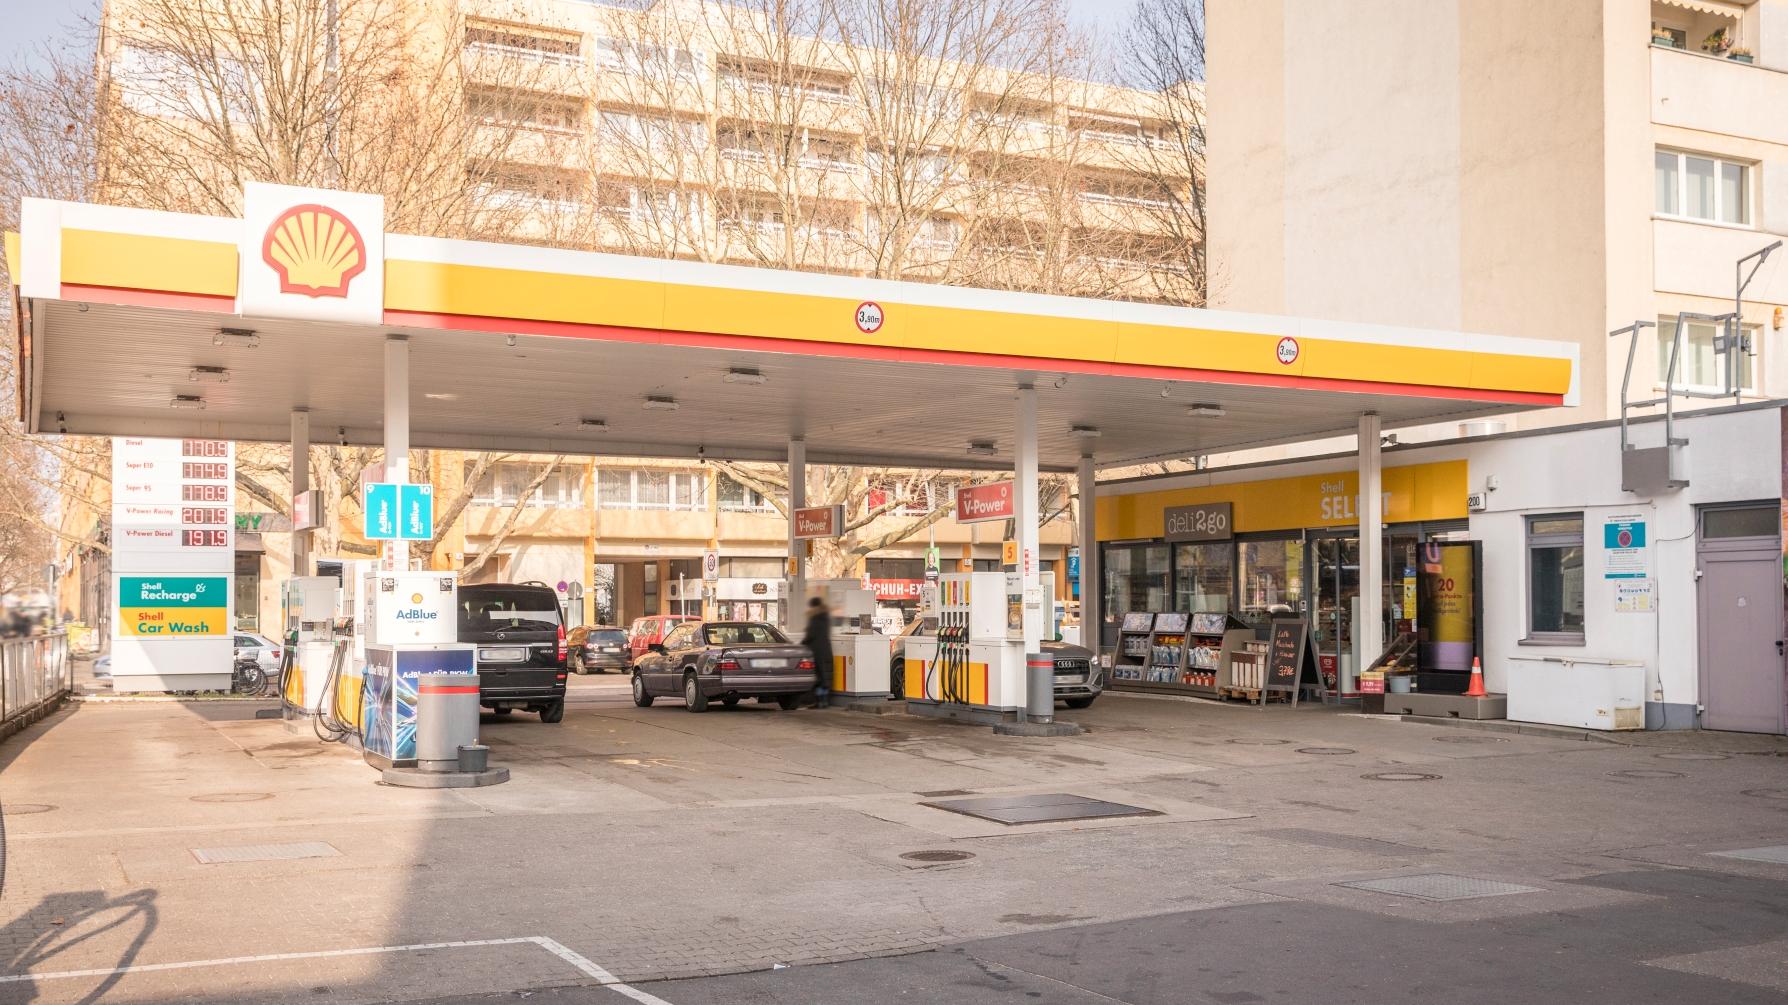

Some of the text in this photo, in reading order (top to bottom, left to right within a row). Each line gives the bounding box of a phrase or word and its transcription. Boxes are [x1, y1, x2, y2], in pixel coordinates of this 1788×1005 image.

[367, 484, 375, 494] 9
[419, 486, 430, 495] 10
[1321, 480, 1344, 494] Shell
[964, 499, 1006, 515] V-Power
[1321, 492, 1392, 520] SELT
[1468, 496, 1480, 506] 200
[799, 520, 827, 532] V-Power
[1168, 510, 1226, 534] deli2go
[1008, 546, 1012, 559] 5
[1438, 578, 1454, 592] 20
[141, 590, 196, 602] Recharge
[138, 612, 164, 620] Shell
[396, 609, 437, 620] AdBlue
[138, 622, 209, 633] Car Wash
